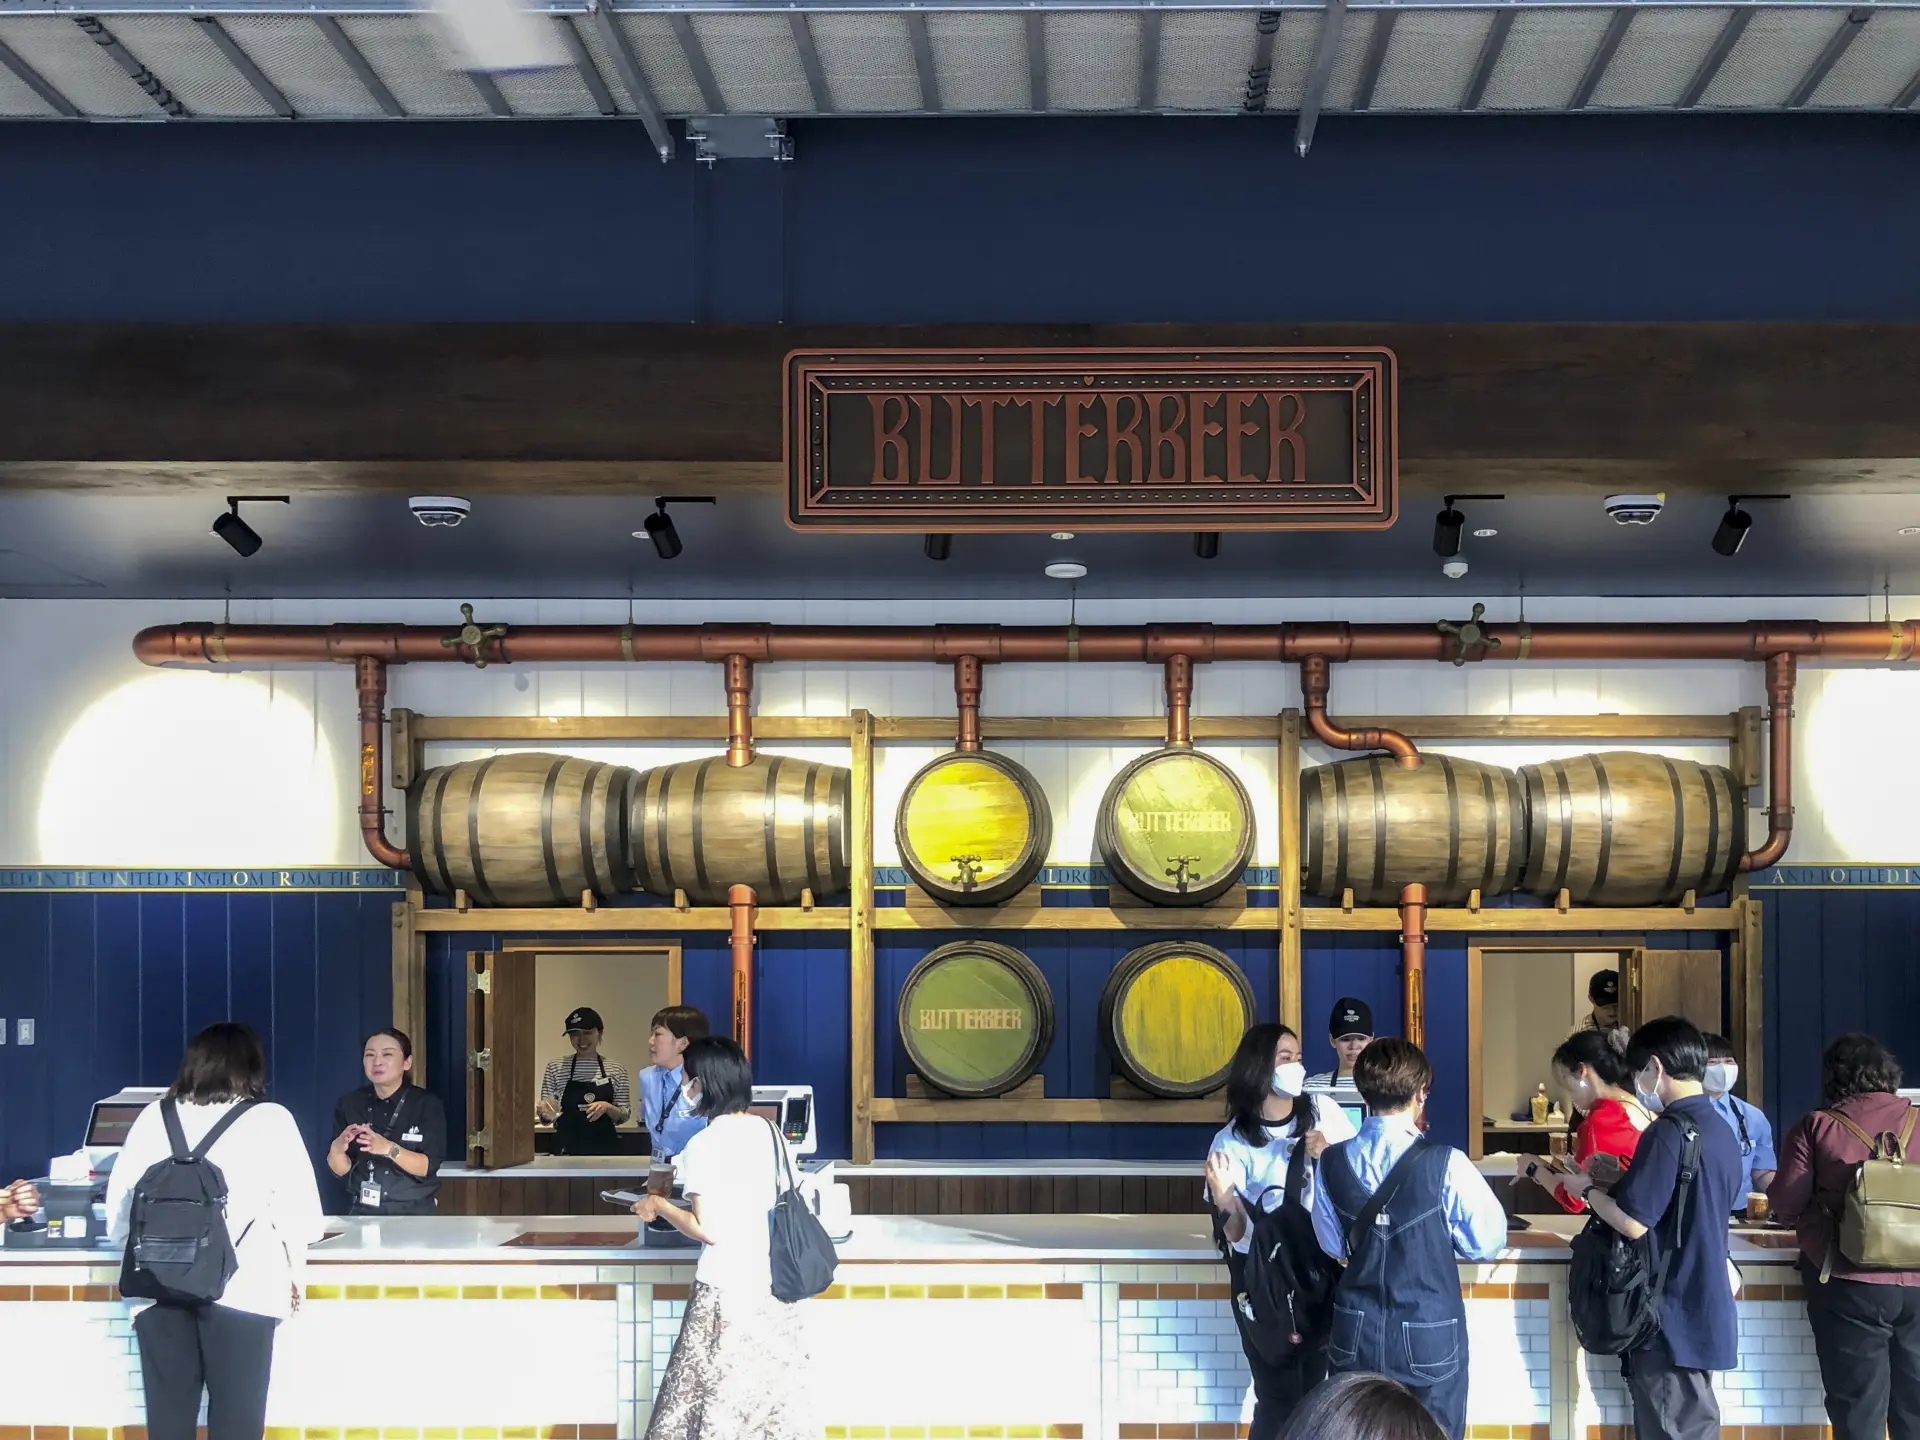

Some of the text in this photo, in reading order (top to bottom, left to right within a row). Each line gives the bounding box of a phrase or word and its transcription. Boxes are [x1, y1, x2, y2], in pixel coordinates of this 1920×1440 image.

[866, 392, 1306, 485] BUTTERBEER
[1129, 811, 1232, 832] BUTTERBEER
[37, 871, 56, 886] IN
[61, 871, 97, 886] THE
[103, 871, 169, 886] UNITED
[174, 871, 264, 886] KINGDOM
[271, 871, 321, 886] FROM
[329, 871, 361, 886] THE
[366, 871, 404, 887] ORI
[1034, 868, 1111, 884] ULDRON
[1240, 869, 1278, 884] CIPE
[1772, 868, 1814, 884] AND
[1821, 868, 1900, 884] BOTTLED
[920, 1009, 1022, 1030] BUTTERBEER
